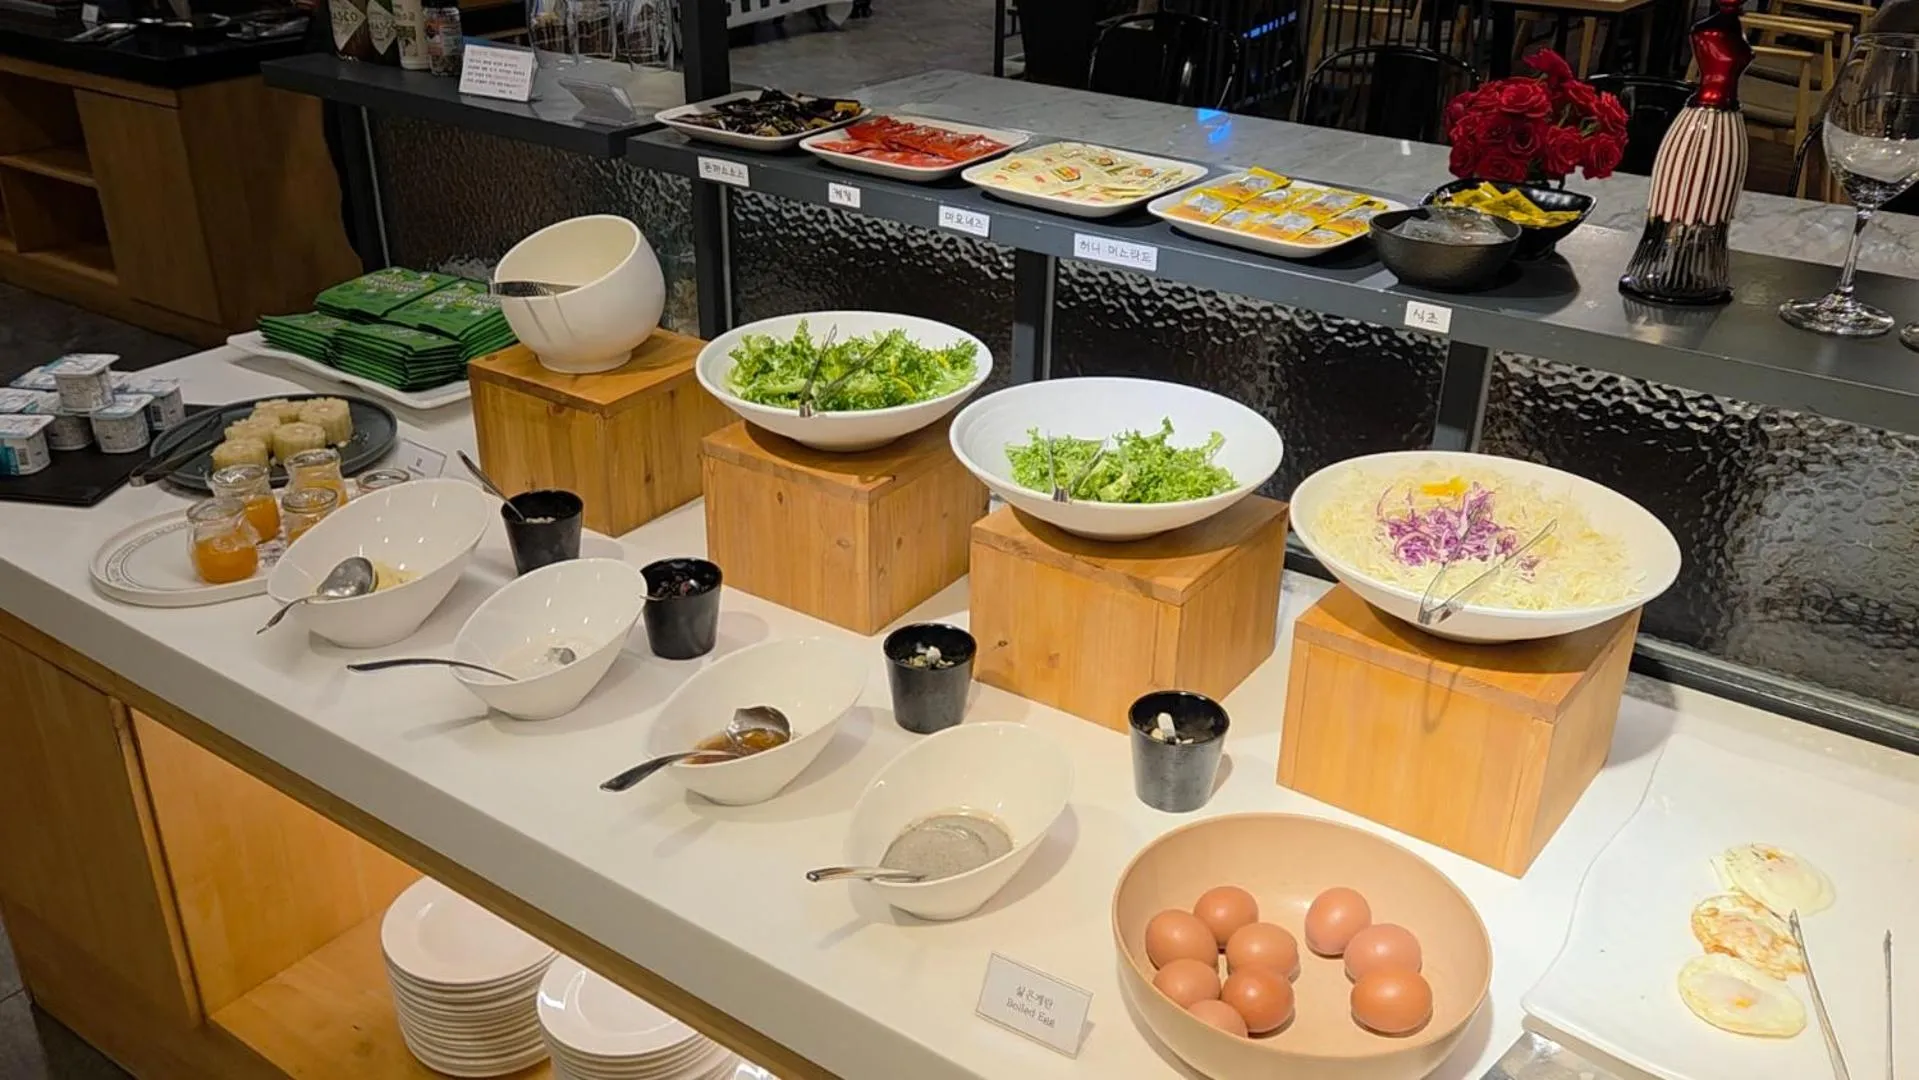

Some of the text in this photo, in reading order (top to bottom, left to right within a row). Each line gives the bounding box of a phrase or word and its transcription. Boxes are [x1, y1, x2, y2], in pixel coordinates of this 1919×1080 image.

[944, 212, 984, 229] 마요네즈
[1079, 240, 1152, 263] 허니 머스타드
[1413, 308, 1441, 325] 식초
[1006, 997, 1055, 1029] Boiled Egg
